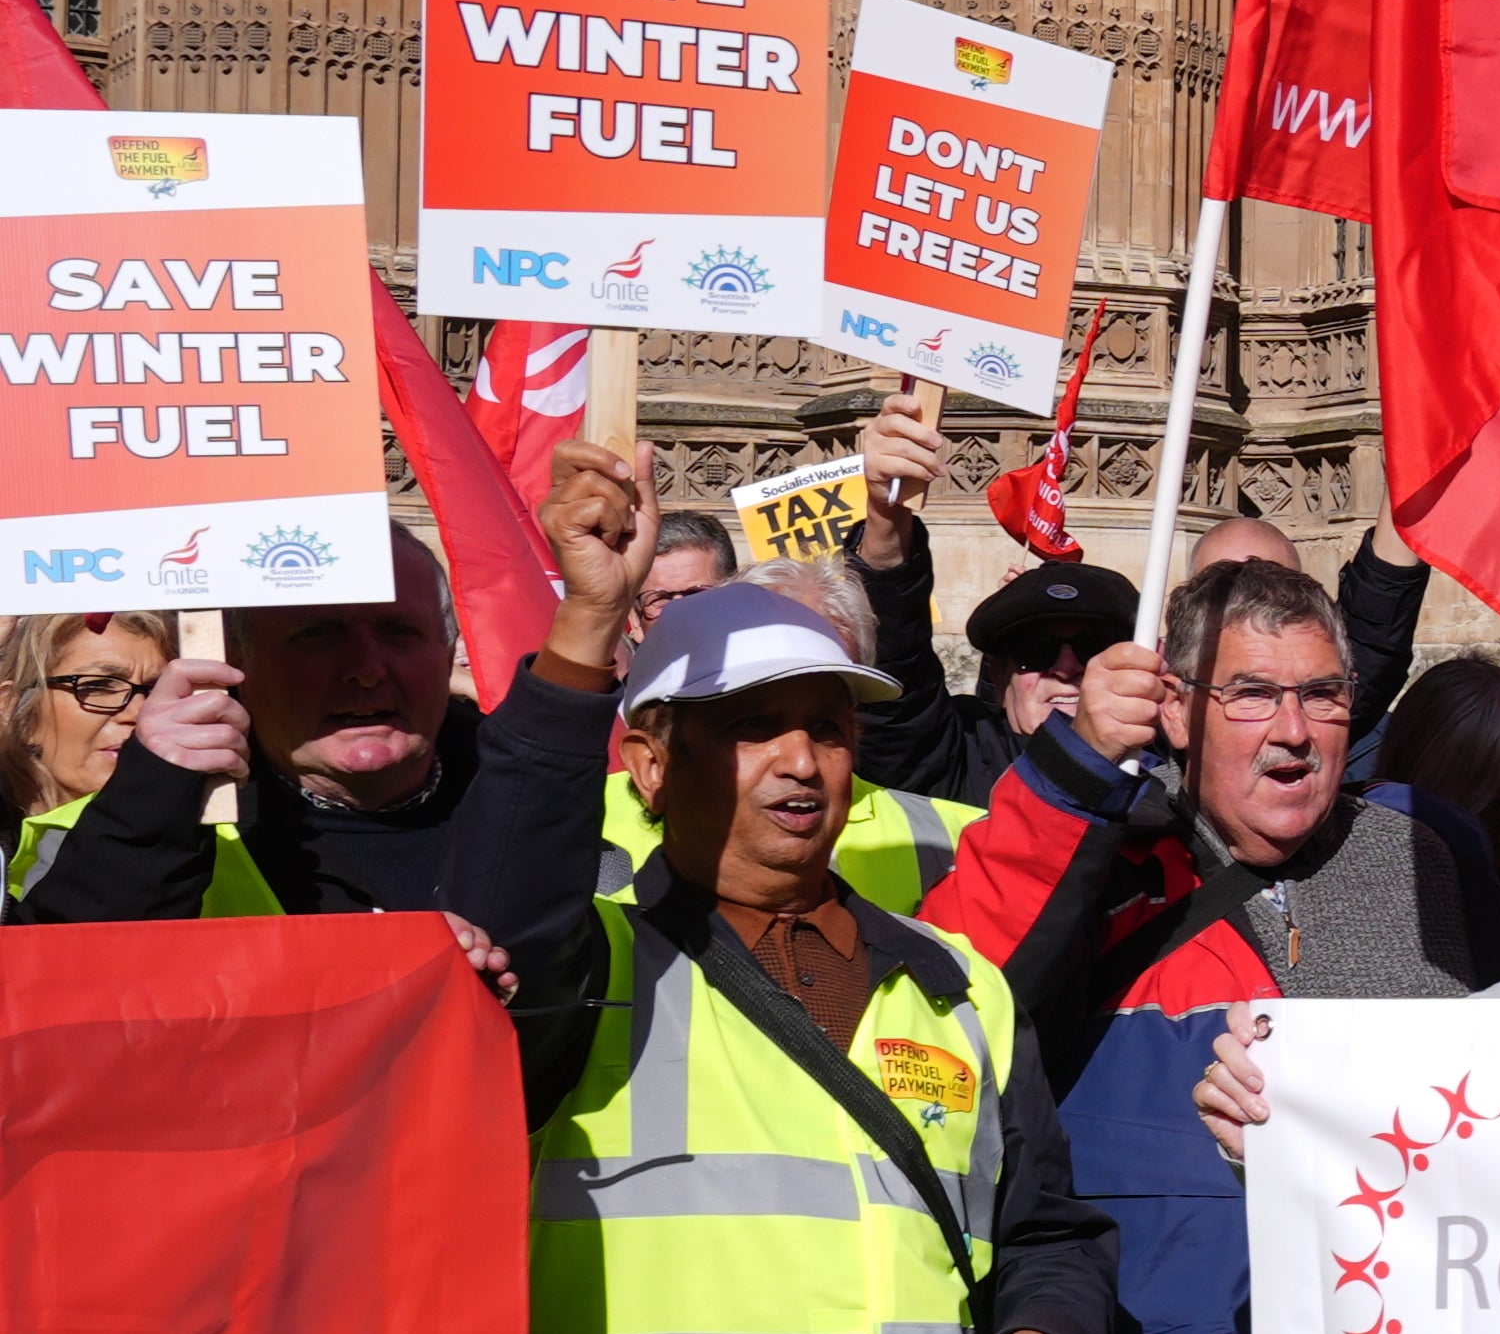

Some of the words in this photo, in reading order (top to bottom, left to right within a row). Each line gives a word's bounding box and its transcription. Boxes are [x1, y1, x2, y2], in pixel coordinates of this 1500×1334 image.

[456, 1, 801, 95] WINTER
[112, 140, 160, 150] DEFEND
[526, 93, 738, 170] FUEL
[116, 152, 139, 162] THE
[142, 153, 171, 163] FUEL
[120, 165, 175, 175] PAYMENT
[887, 115, 1046, 196] DON'T
[873, 165, 956, 222] LET
[974, 192, 1042, 246] US
[473, 246, 570, 289] NPC
[857, 210, 1042, 301] FREEZE
[46, 257, 281, 314] SAVE
[590, 280, 649, 302] unite
[840, 309, 899, 347] NPC
[0, 330, 347, 385] WINTER
[68, 405, 291, 461] FUEL
[757, 483, 855, 533] TAX
[23, 548, 126, 584] NPC
[147, 567, 209, 586] unite
[880, 1043, 929, 1062] DEFEND
[886, 1060, 911, 1075] THE
[914, 1064, 943, 1080] FUEL
[889, 1078, 946, 1099] PAYMENT
